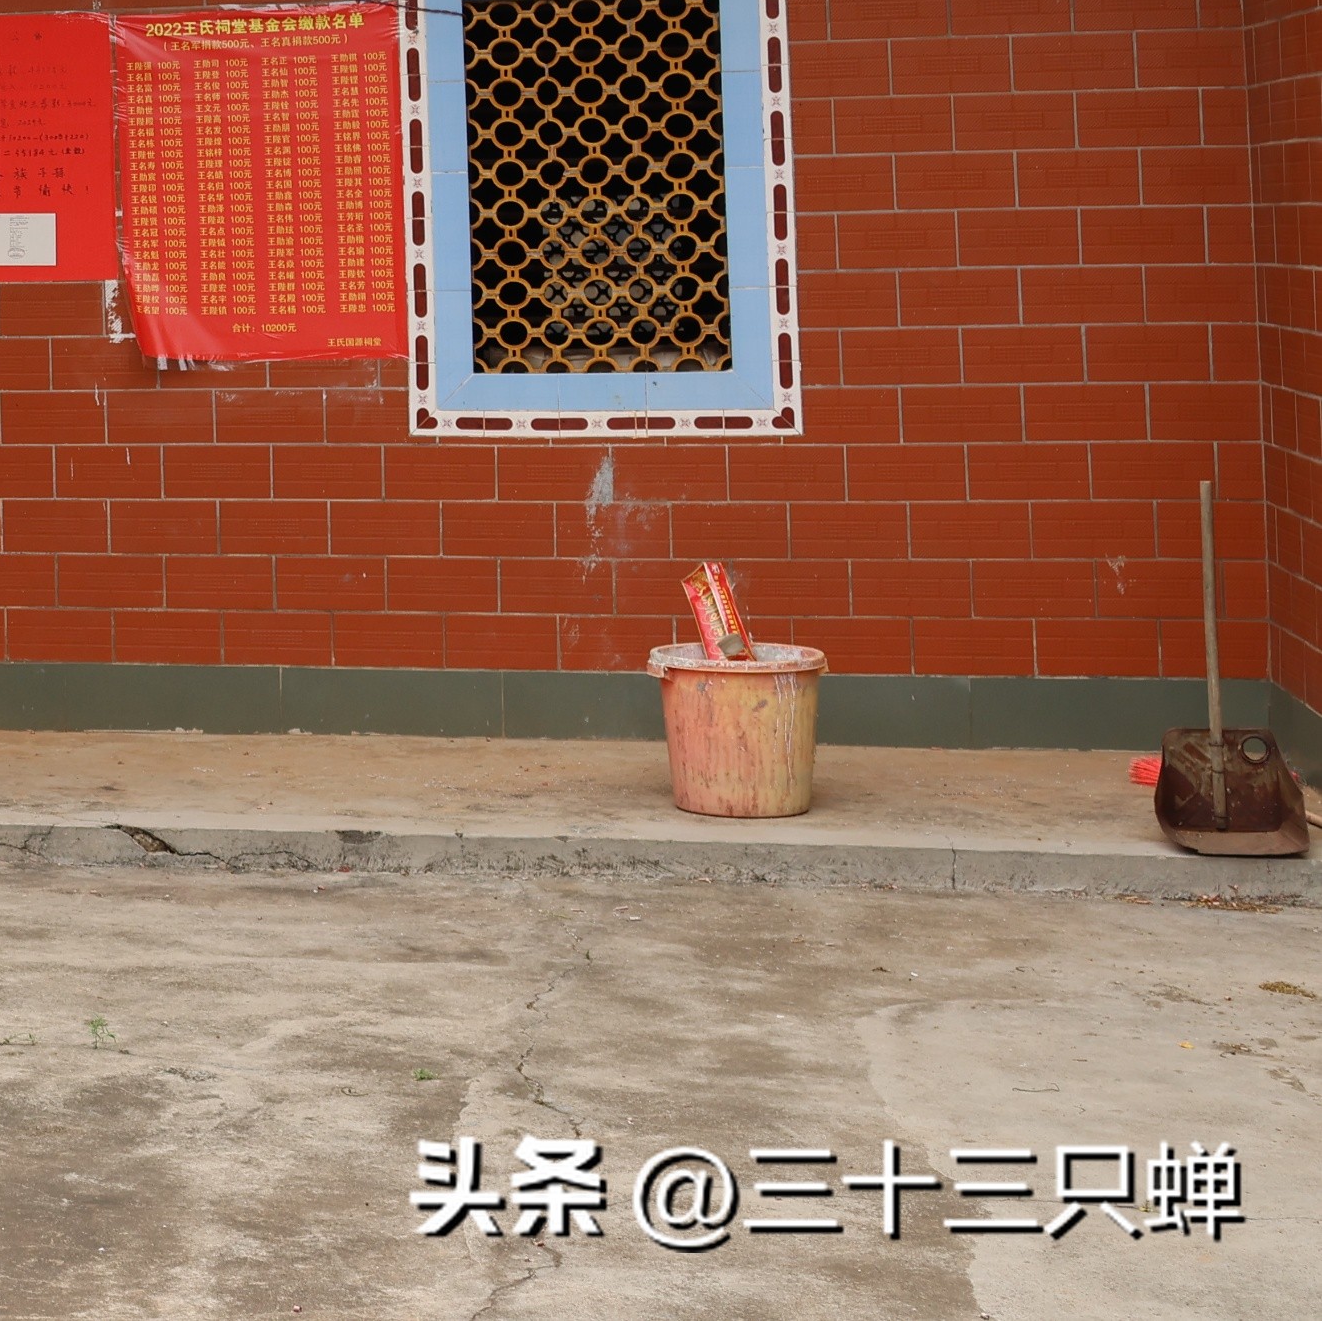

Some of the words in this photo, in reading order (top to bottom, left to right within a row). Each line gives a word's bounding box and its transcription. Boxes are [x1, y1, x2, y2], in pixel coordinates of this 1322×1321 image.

[145, 13, 365, 37] 2022王氏祠堂基金会缴款名单
[293, 55, 317, 64] 100元
[363, 51, 387, 61] 100元
[157, 60, 180, 70] 100元
[225, 58, 249, 67] 100元
[294, 77, 318, 87] 100元
[364, 74, 388, 83] 100元
[158, 82, 181, 92] 100元
[226, 80, 249, 89] 100元
[295, 99, 319, 109] 100元
[365, 96, 389, 106] 100元
[159, 104, 182, 114] 100元
[226, 102, 250, 112] 100元
[227, 124, 251, 134] 100元
[296, 122, 320, 131] 100元
[366, 119, 390, 129] 100元
[160, 127, 183, 136] 100元
[228, 147, 252, 156] 100元
[297, 144, 320, 154] 100元
[367, 142, 390, 152] 100元
[161, 149, 183, 158] 100元
[229, 169, 252, 179] 100元
[297, 167, 321, 177] 100元
[367, 165, 391, 175] 100元
[161, 171, 184, 181] 100元
[229, 192, 253, 202] 100元
[298, 190, 322, 200] 100元
[368, 188, 392, 198] 100元
[162, 194, 185, 203] 100元
[163, 216, 186, 226] 100元
[230, 215, 253, 224] 100元
[299, 213, 323, 222] 100元
[369, 211, 393, 221] 100元
[164, 238, 187, 248] 100元
[231, 237, 254, 247] 100元
[300, 236, 324, 245] 100元
[369, 234, 393, 244] 100元
[164, 261, 187, 271] 100元
[231, 260, 255, 269] 100元
[300, 259, 324, 268] 100元
[370, 257, 394, 267] 100元
[165, 284, 187, 293] 100元
[232, 283, 256, 292] 100元
[301, 281, 325, 291] 100元
[371, 280, 395, 289] 100元
[165, 306, 187, 316] 100元
[232, 305, 256, 315] 100元
[302, 304, 326, 314] 100元
[372, 303, 395, 312] 100元
